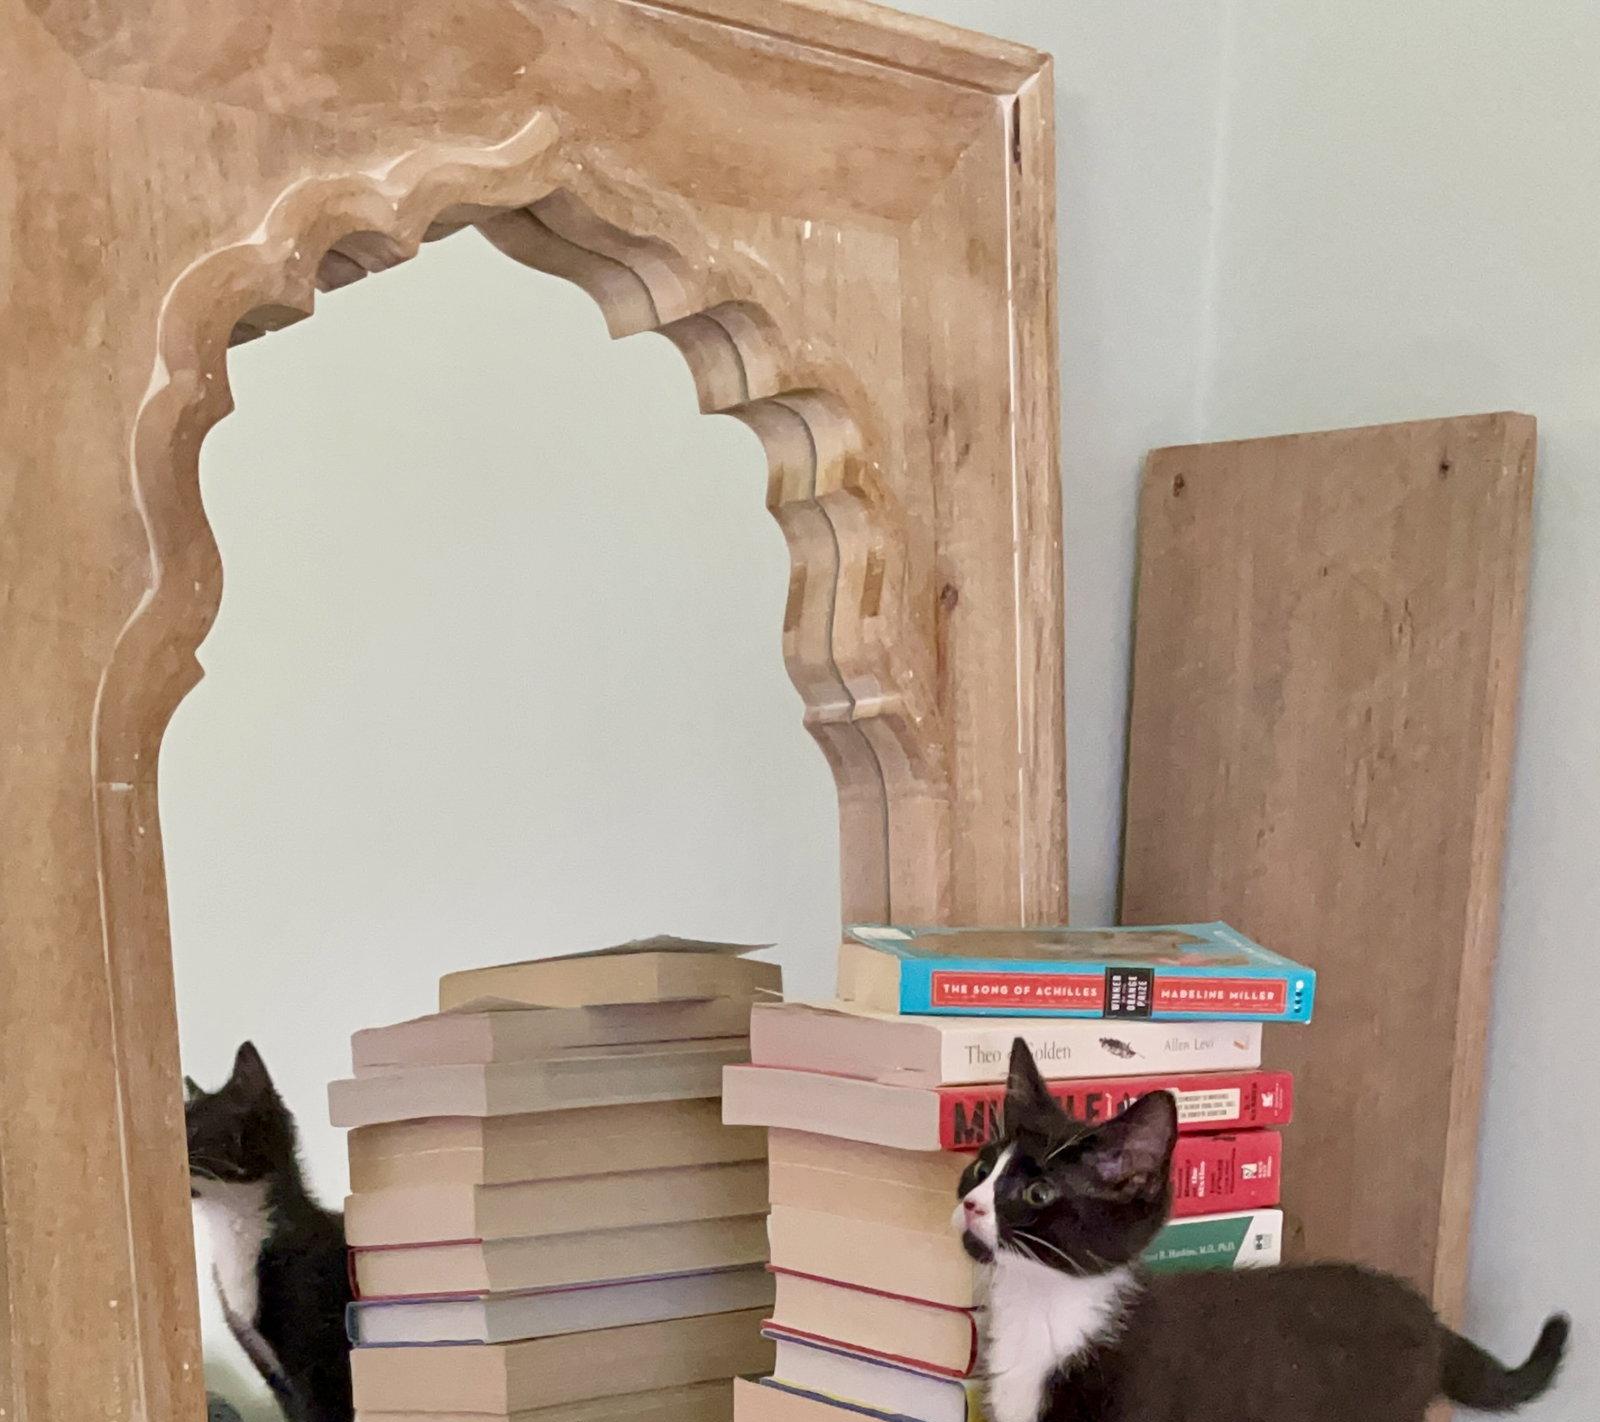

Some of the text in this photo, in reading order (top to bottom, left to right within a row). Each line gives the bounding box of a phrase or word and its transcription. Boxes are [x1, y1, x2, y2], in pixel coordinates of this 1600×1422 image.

[943, 984, 1097, 997] THE SONG OF ACHILLES
[1111, 975, 1122, 1011] WINNER
[1126, 976, 1138, 1011] ORANGE
[1137, 980, 1147, 1007] PRIZE
[1161, 990, 1275, 1000] MADELINE MILLER
[964, 1044, 1002, 1064] Theo
[1029, 1041, 1071, 1061] olden
[1164, 1039, 1190, 1051] Allen
